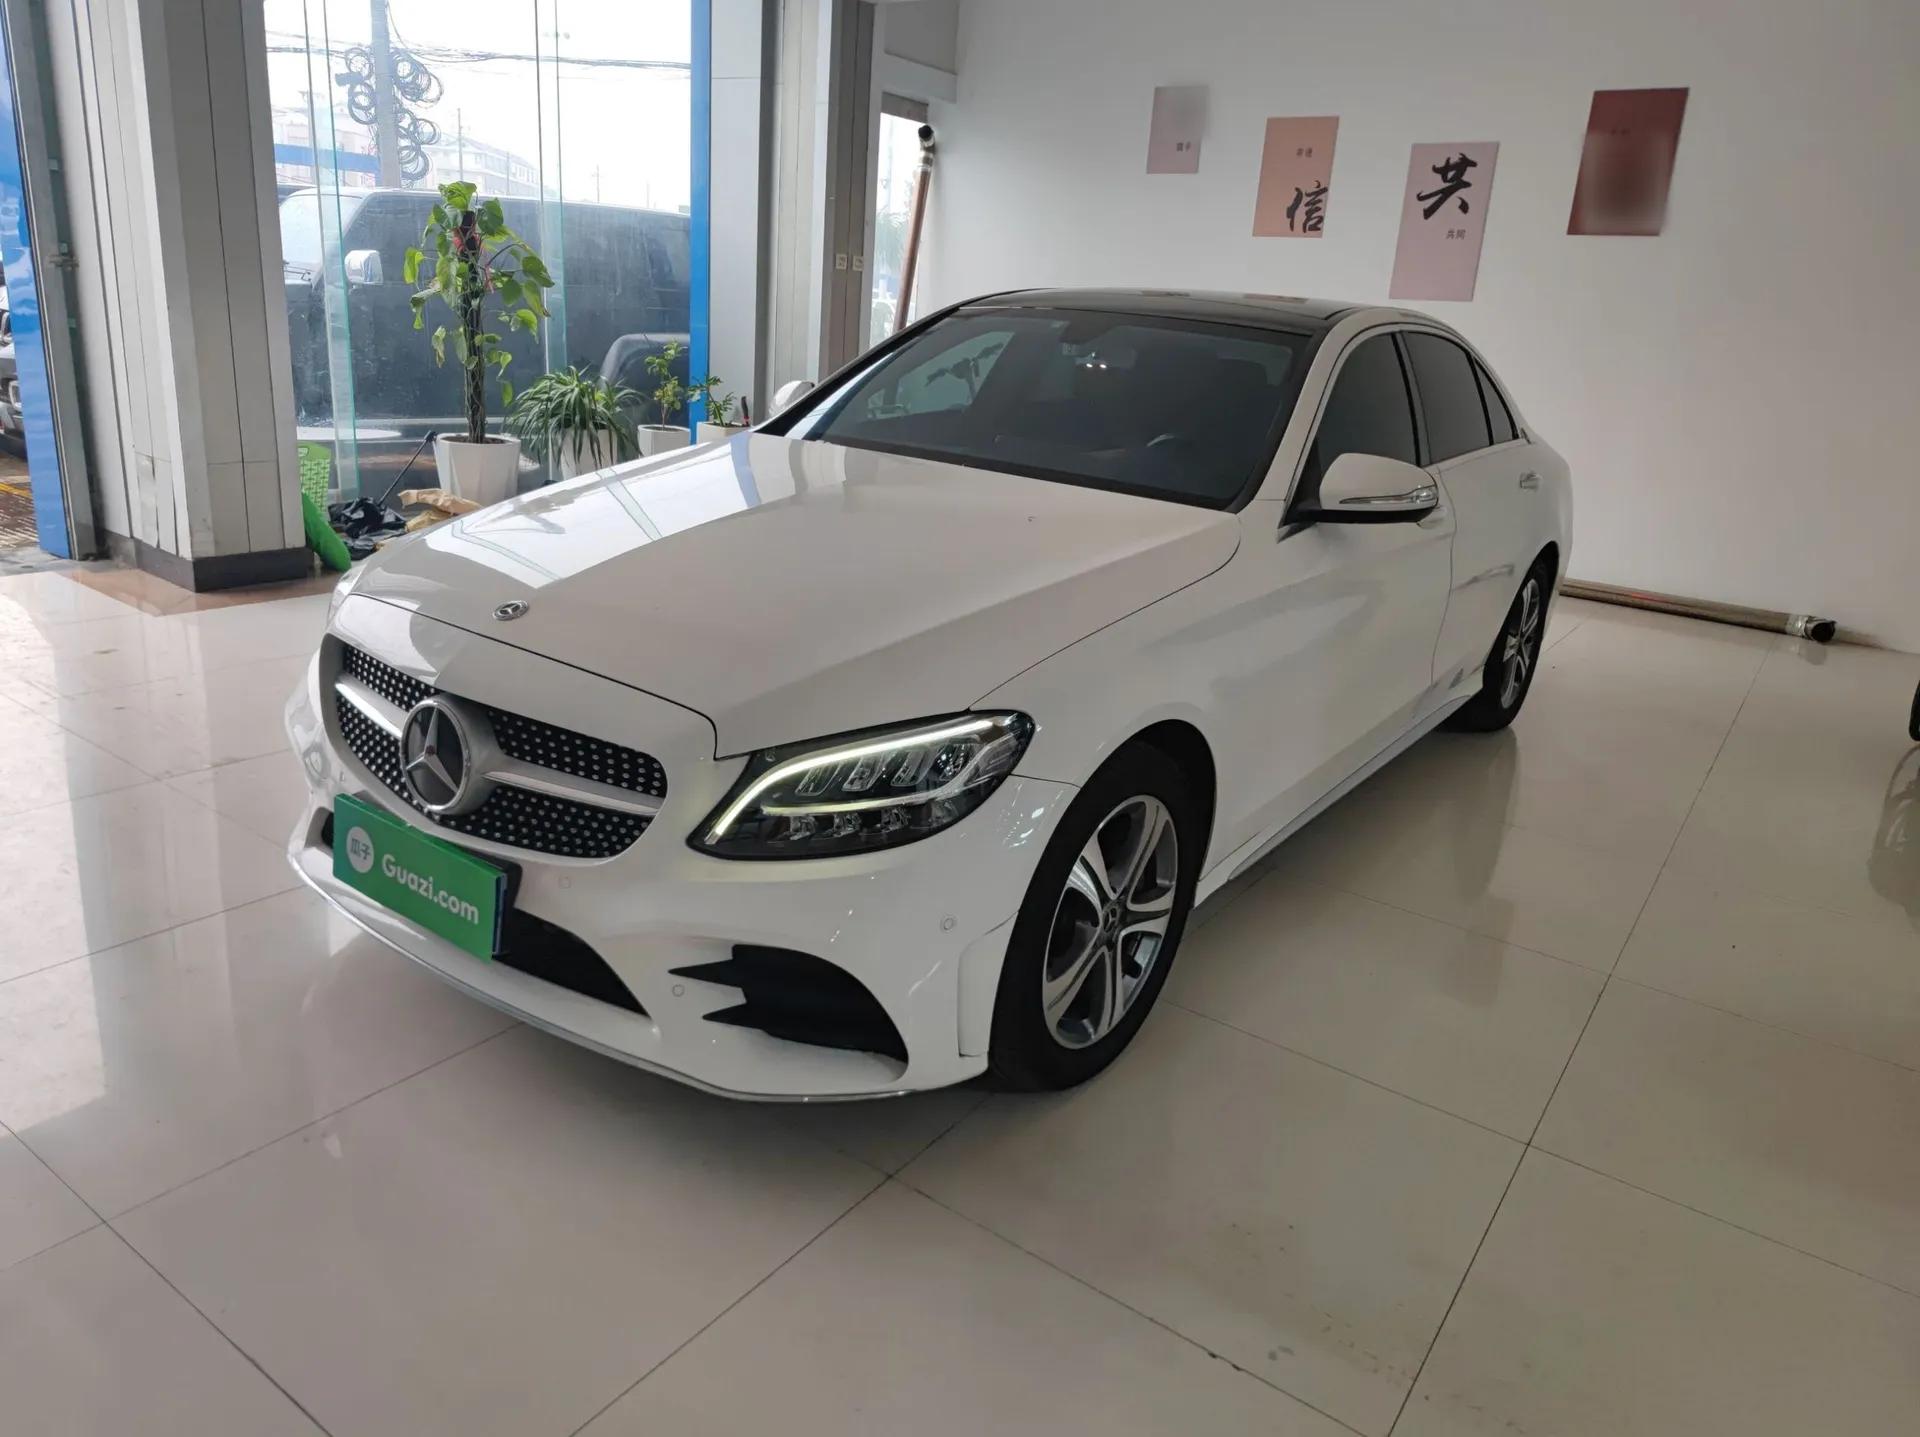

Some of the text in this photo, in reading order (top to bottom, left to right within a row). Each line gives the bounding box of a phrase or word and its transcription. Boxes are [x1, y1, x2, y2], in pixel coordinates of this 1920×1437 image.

[1286, 180, 1329, 233] 信
[1416, 152, 1478, 220] 共
[351, 837, 371, 860] 瓜子
[381, 853, 479, 925] Guazi.com
